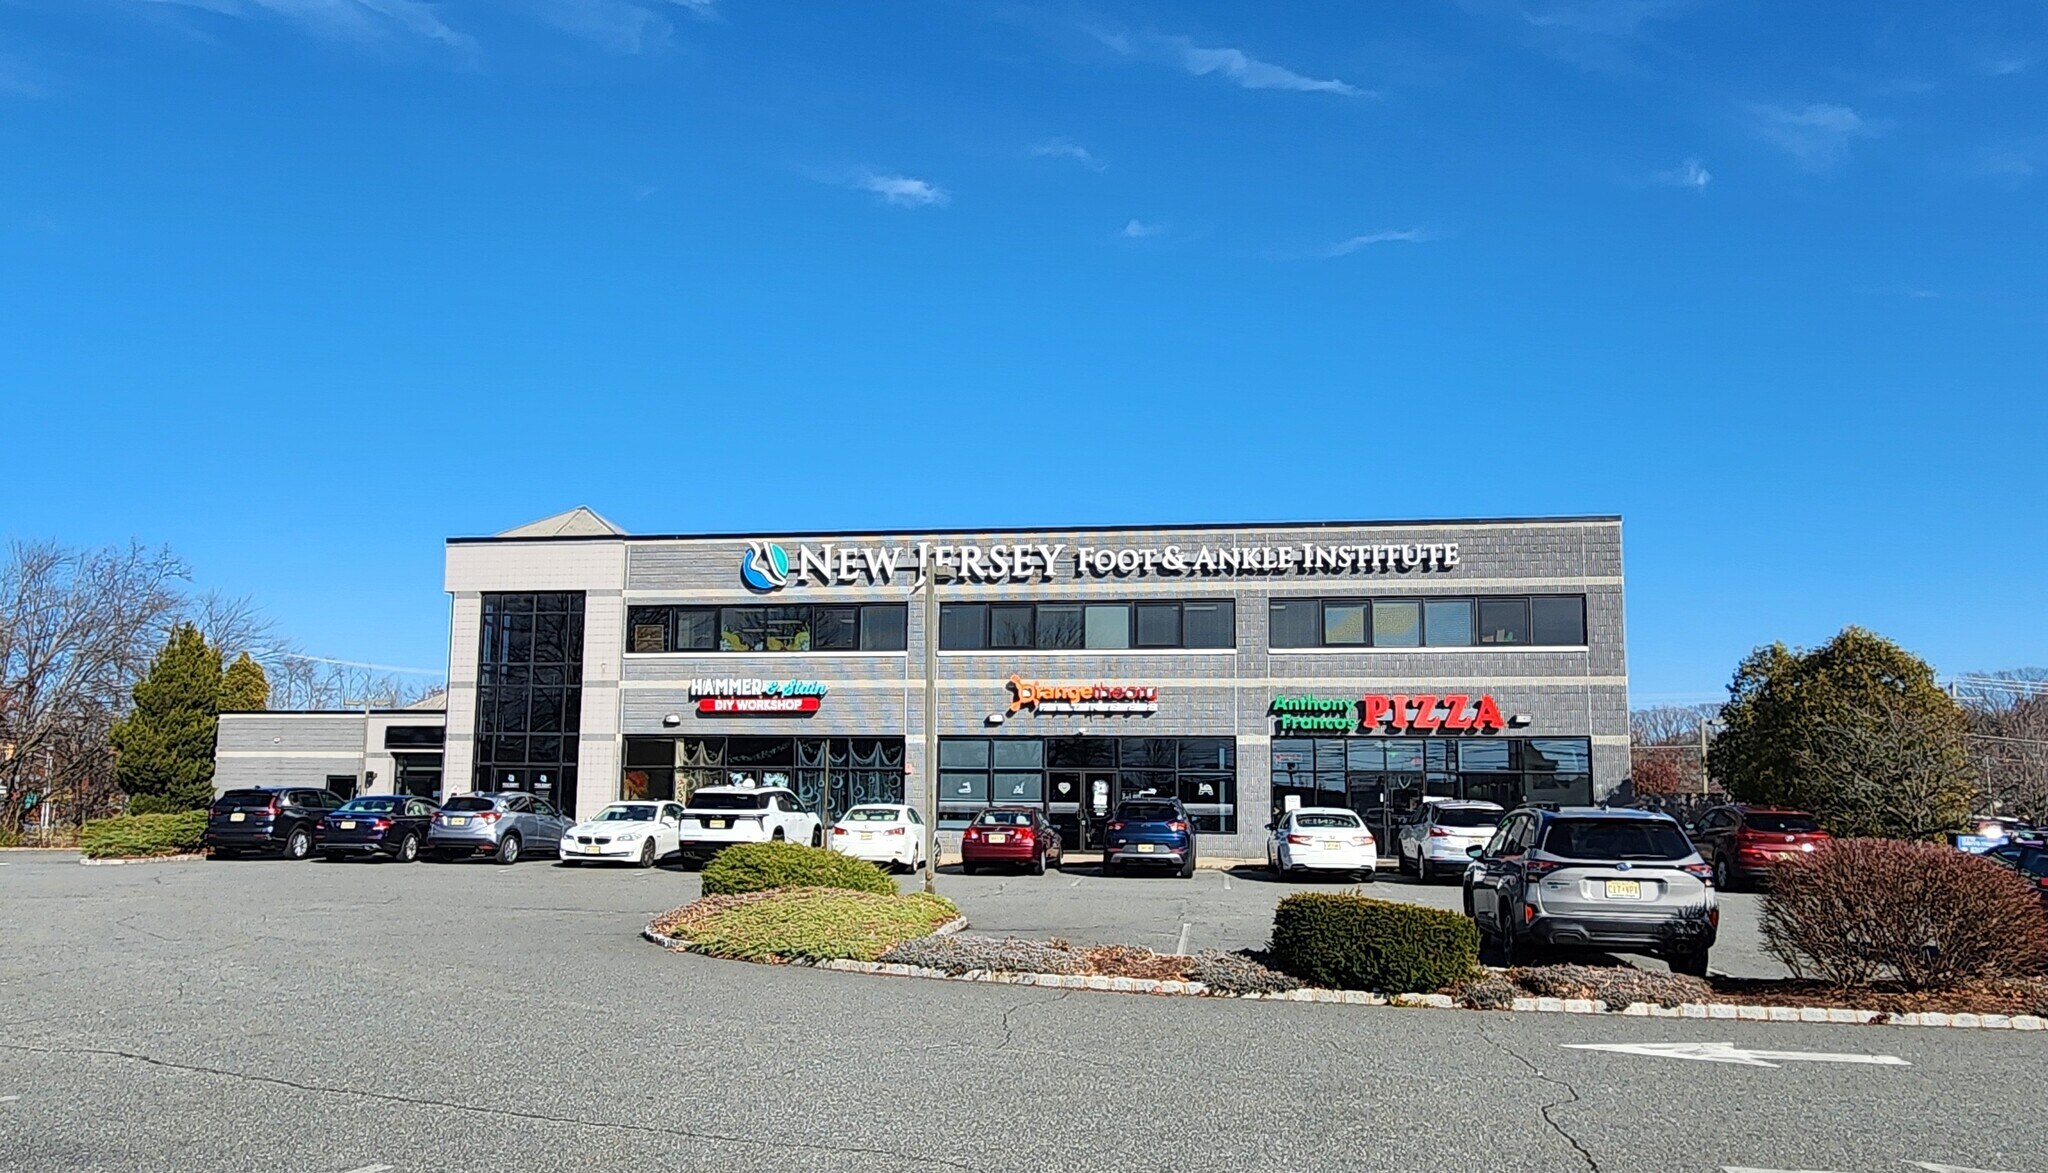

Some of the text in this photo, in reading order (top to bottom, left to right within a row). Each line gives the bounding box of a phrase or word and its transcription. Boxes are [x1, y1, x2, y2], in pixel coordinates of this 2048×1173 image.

[798, 541, 1460, 587] NEW JERSEY FOOT & ANKLE INSTITUTE
[691, 678, 827, 697] HAMMER & Stain
[713, 699, 802, 711] DIY WORKSHOP
[1273, 694, 1355, 714] Anthony
[1363, 693, 1505, 729] PIZZA
[1281, 714, 1356, 731] Francos
